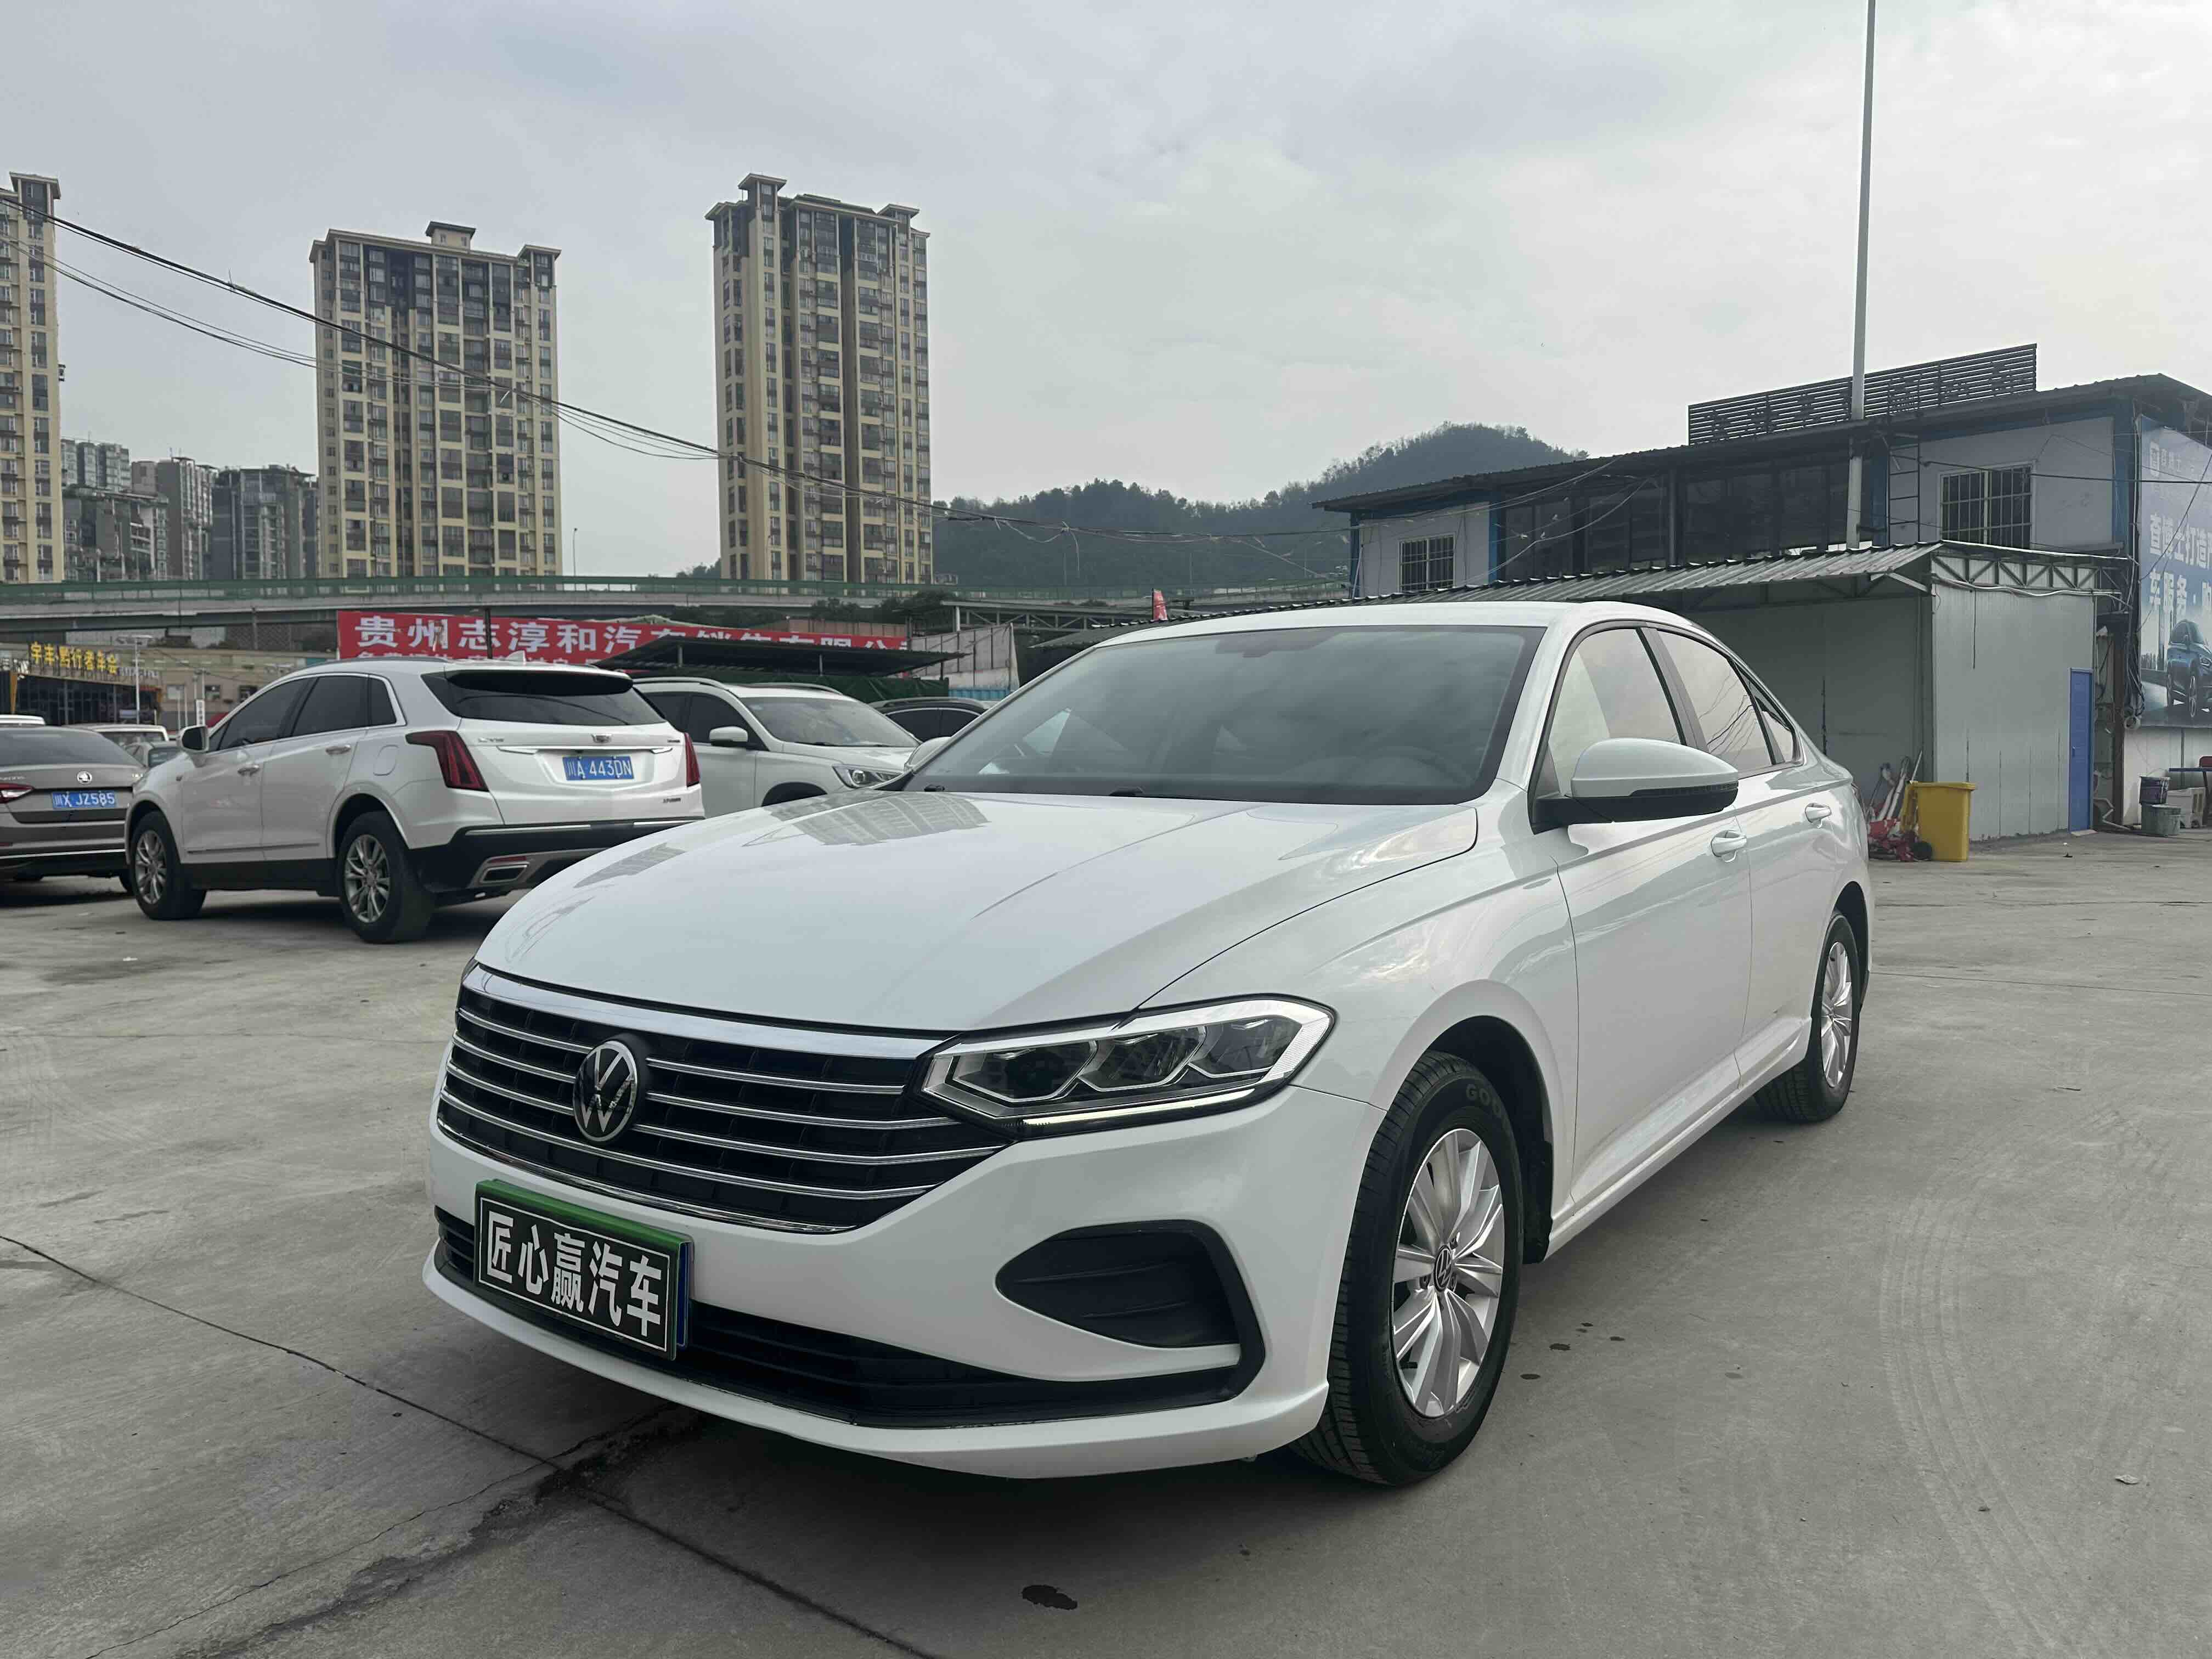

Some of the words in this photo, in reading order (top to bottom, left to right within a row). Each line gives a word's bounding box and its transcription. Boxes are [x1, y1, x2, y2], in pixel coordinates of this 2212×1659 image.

[487, 1211, 662, 1338] 匠心赢汽车
